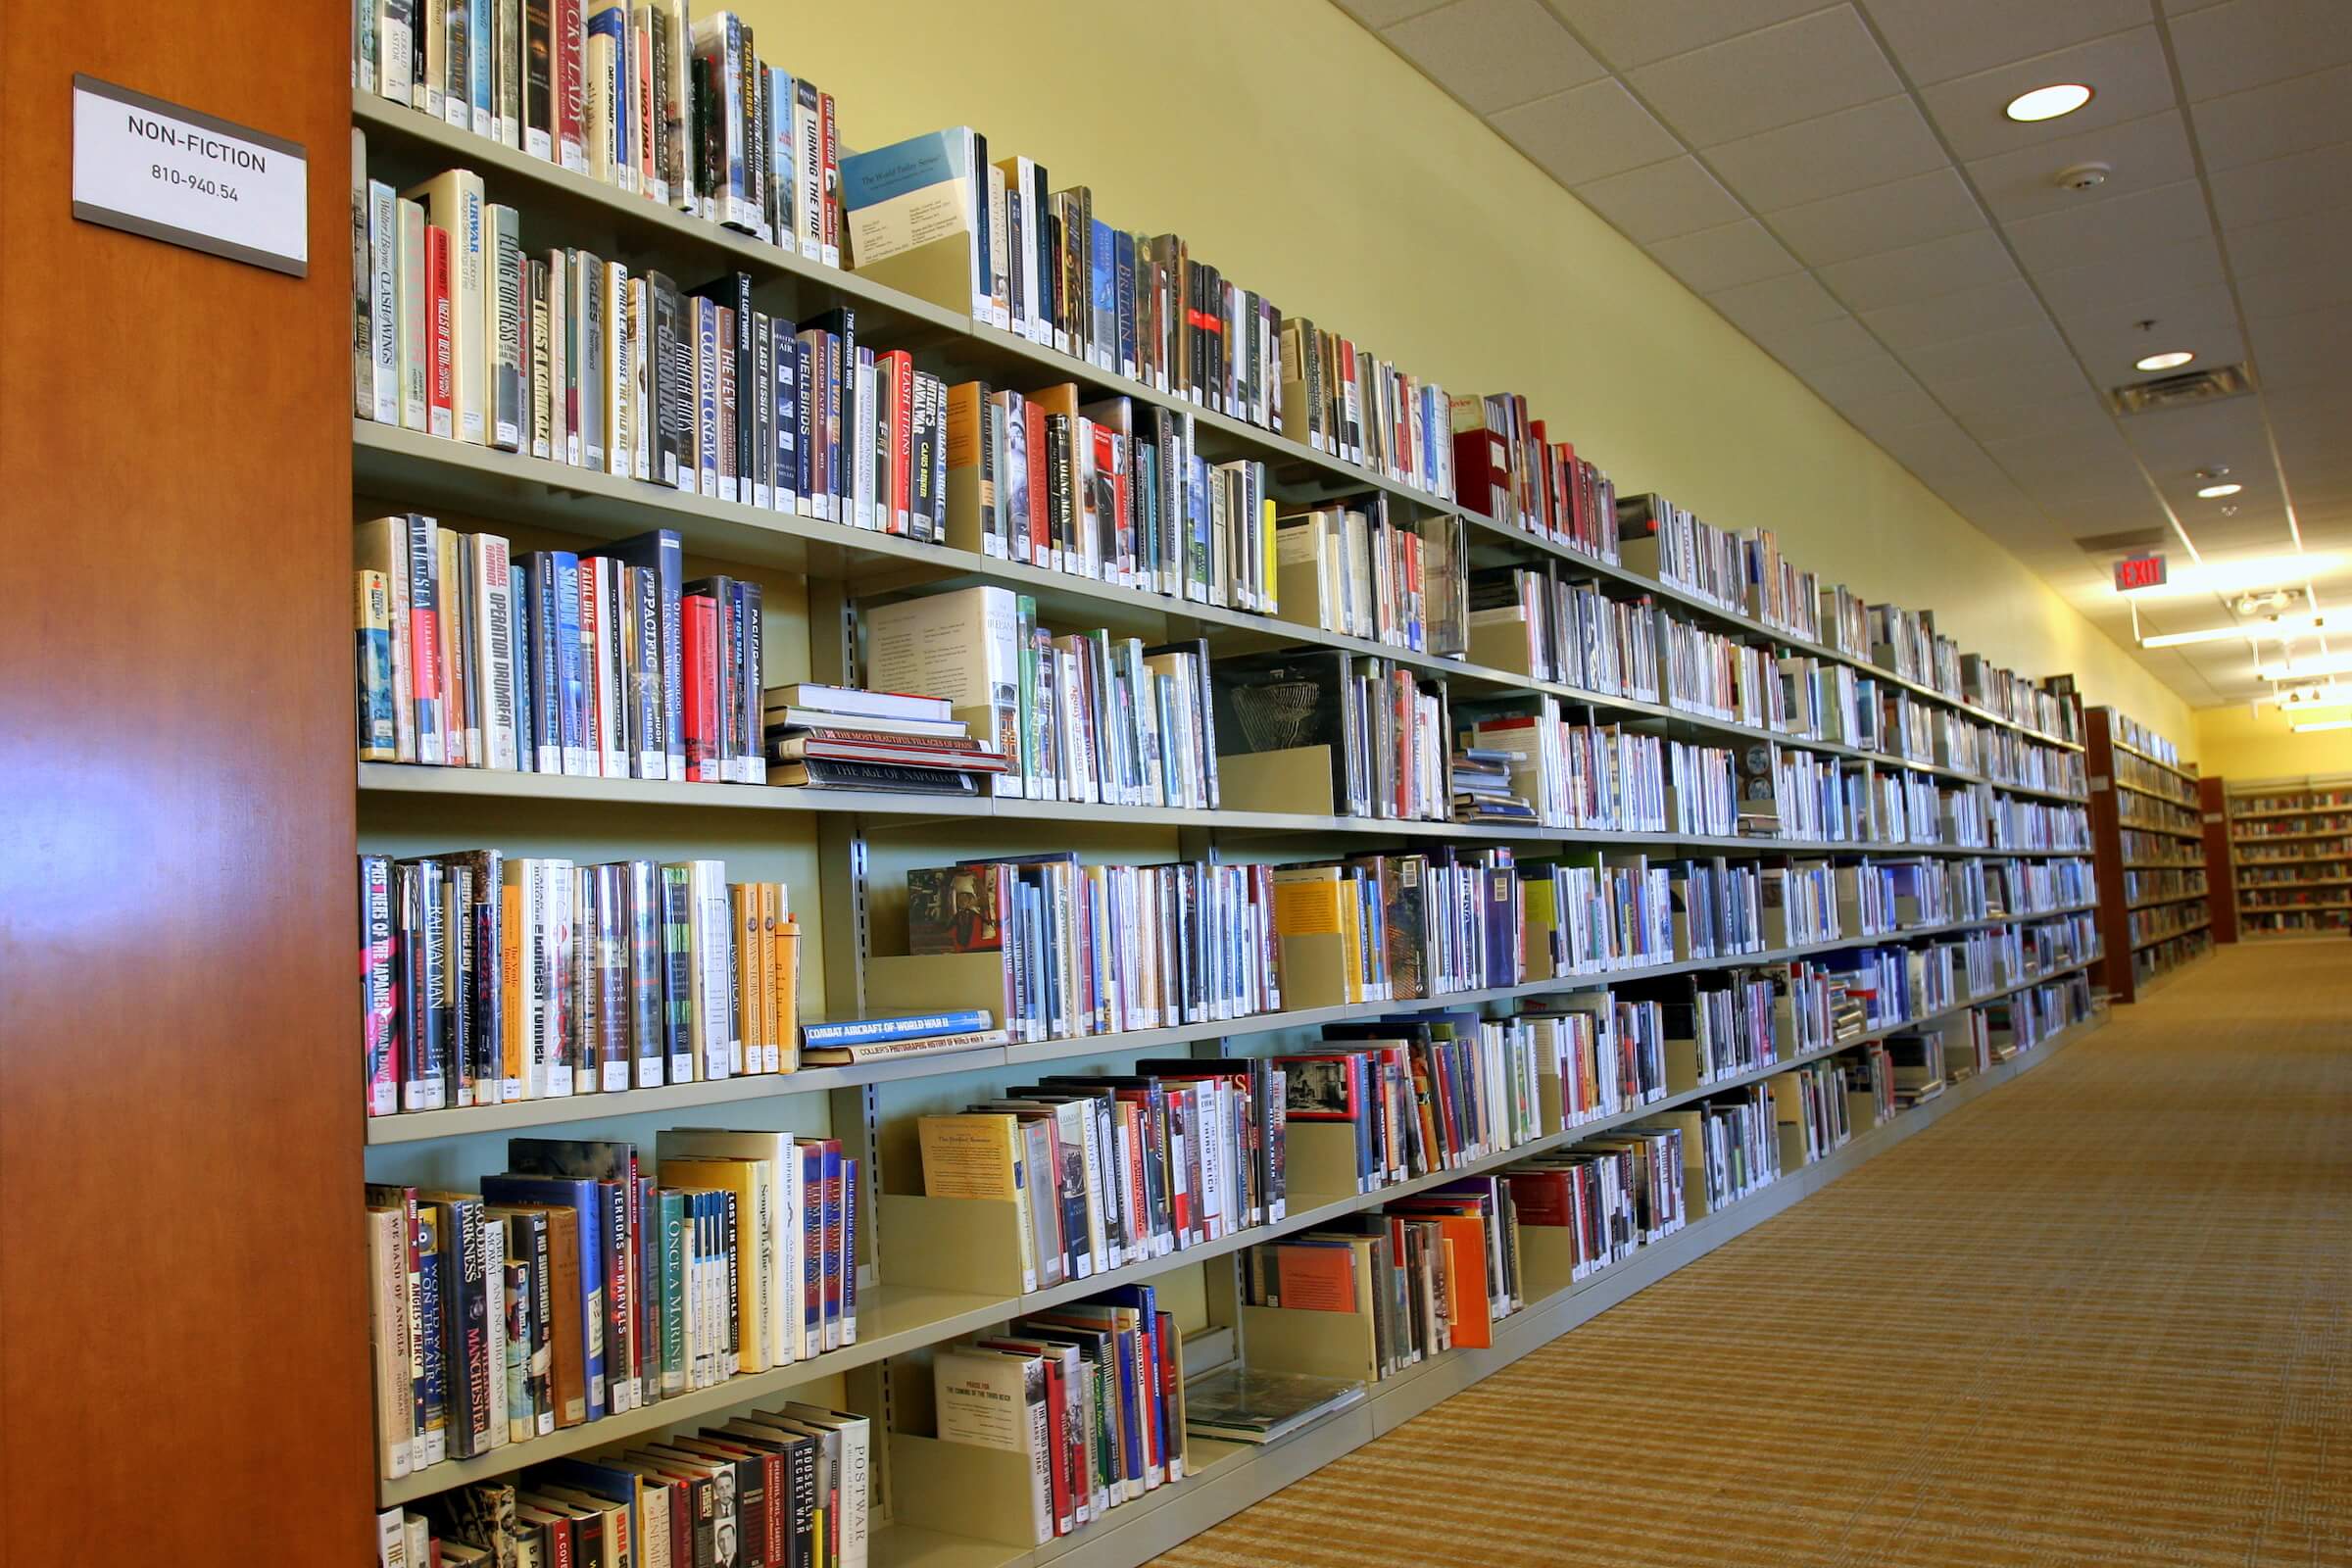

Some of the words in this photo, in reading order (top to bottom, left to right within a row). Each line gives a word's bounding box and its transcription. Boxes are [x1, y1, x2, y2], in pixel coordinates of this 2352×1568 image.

[400, 30, 409, 68] GERALD
[640, 79, 650, 115] IWO
[128, 116, 265, 172] NON-FICTION
[641, 118, 650, 160] JIMA
[807, 118, 818, 176] TURNING
[152, 165, 238, 202] 810-940.54
[809, 181, 819, 206] THE
[809, 211, 820, 240] TIDE
[499, 232, 517, 279] FLYING
[500, 280, 518, 344] FORTRESS
[589, 260, 598, 322] EAGLES
[1119, 264, 1132, 342] BRITAIN
[658, 324, 676, 439] GERONIMO!
[676, 343, 693, 397] FIGHTER
[702, 330, 715, 406] COMBAT
[722, 348, 735, 373] THE
[902, 362, 911, 403] CLASH
[723, 377, 735, 410] FEW
[760, 375, 768, 423] MISSION
[800, 352, 810, 436] HELLBIRDS
[913, 375, 925, 412] NAVAL
[926, 378, 936, 426] HITLER'S
[678, 400, 694, 434] BOYS
[703, 407, 715, 460] CREW
[903, 410, 911, 456] TITANS
[913, 413, 925, 434] WAR
[920, 441, 929, 467] CAJUS
[919, 468, 928, 498] BEKKER
[1059, 459, 1070, 495] YOUNG
[1061, 499, 1070, 523] MEN
[485, 544, 496, 586] GANNON
[495, 543, 507, 588] MICHAEL
[581, 566, 593, 598] FATAL
[2123, 557, 2160, 588] EXIT
[558, 565, 579, 625] SHADOW
[583, 601, 594, 624] DIVE
[490, 592, 507, 659] OPERATION
[644, 596, 658, 668] PACIFIC
[560, 628, 581, 679] DIVERS
[493, 662, 512, 729] DRUMBEAT
[836, 730, 851, 739] THE
[854, 732, 872, 742] MOST
[835, 764, 858, 776] THE
[860, 766, 882, 777] AGE
[884, 768, 900, 779] OF
[429, 905, 444, 968] RAILWAY
[534, 935, 544, 1000] LONGEST
[430, 974, 444, 1009] MAN
[534, 1006, 544, 1064] TUNNEL
[808, 1026, 843, 1039] COMBAT
[844, 1023, 882, 1036] AIRCRAFT
[884, 1023, 896, 1033] OF
[897, 1020, 926, 1032] WORLD
[925, 1018, 942, 1029] WAR
[943, 1018, 949, 1028] II
[859, 1045, 890, 1055] COLLIER'S
[889, 1042, 927, 1054] PHOTOGRAPHIC
[927, 1041, 947, 1051] HISTORY
[955, 1037, 970, 1047] WORLD
[1085, 1116, 1097, 1171] LONDON
[613, 1190, 624, 1250] TERRORS
[810, 1184, 821, 1215] TOM
[392, 1218, 399, 1239] WE
[463, 1204, 476, 1283] DARKNESS
[475, 1203, 485, 1278] GOODBYE,
[537, 1235, 546, 1252] NO
[667, 1220, 680, 1273] ONCE
[729, 1229, 736, 1242] IN
[487, 1232, 496, 1277] MOWAT
[810, 1217, 821, 1293] BROKAW
[394, 1285, 402, 1298] OF
[422, 1278, 431, 1303] ON
[538, 1254, 549, 1323] SURRENDER
[615, 1274, 626, 1335] MARVELS
[669, 1278, 680, 1289] A
[395, 1306, 404, 1356] ANGELS
[423, 1312, 432, 1346] THE
[494, 1314, 501, 1333] NO
[669, 1296, 682, 1370] MARINE
[424, 1351, 434, 1383] AIR
[467, 1328, 485, 1433] MANCHESTER
[796, 1450, 805, 1499] SECRET
[804, 1447, 813, 1532] ROOSEVELT'S
[855, 1446, 865, 1542] POSTWAR
[702, 1483, 712, 1518] CASEY
[796, 1508, 805, 1534] WAR
